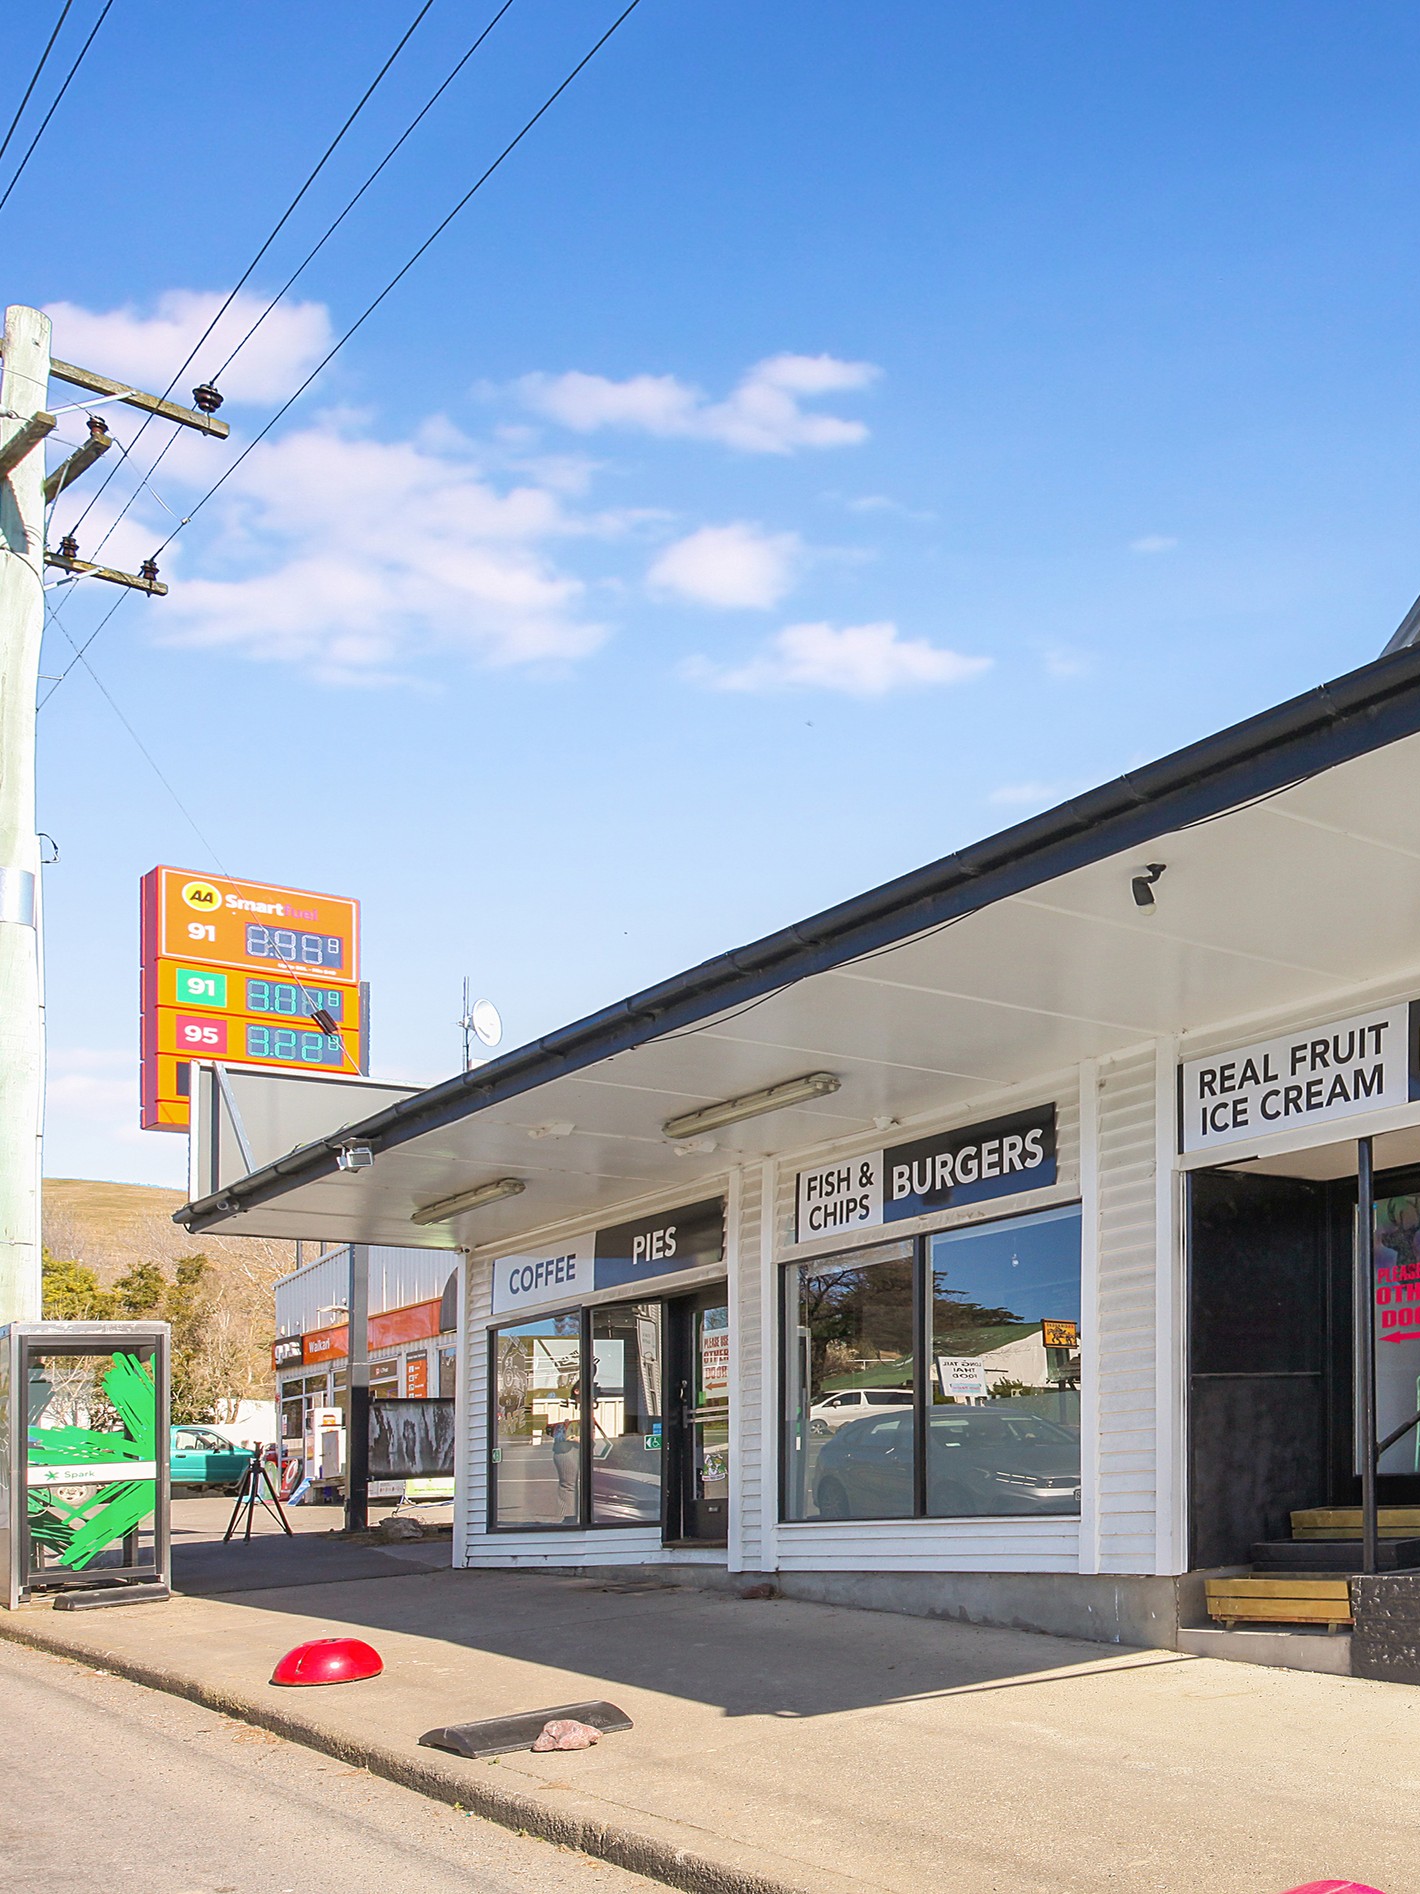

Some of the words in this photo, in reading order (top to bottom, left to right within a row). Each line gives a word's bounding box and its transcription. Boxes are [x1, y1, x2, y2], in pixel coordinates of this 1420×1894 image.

[190, 890, 213, 904] AA
[225, 894, 318, 921] Smartfuel
[187, 922, 216, 942] 91
[187, 977, 215, 997] 91
[184, 1025, 219, 1044] 95
[1200, 1053, 1278, 1099] REAL
[1290, 1021, 1389, 1076] FRUIT
[1201, 1097, 1248, 1136] ICE
[1260, 1063, 1384, 1120] CREAM
[807, 1167, 850, 1201] FISH
[858, 1162, 874, 1188] &
[893, 1128, 1044, 1201] BURGERS
[809, 1194, 869, 1231] CHIPS
[633, 1226, 677, 1265] PIES
[509, 1253, 576, 1295] COFFEE
[64, 1471, 95, 1479] Spark
